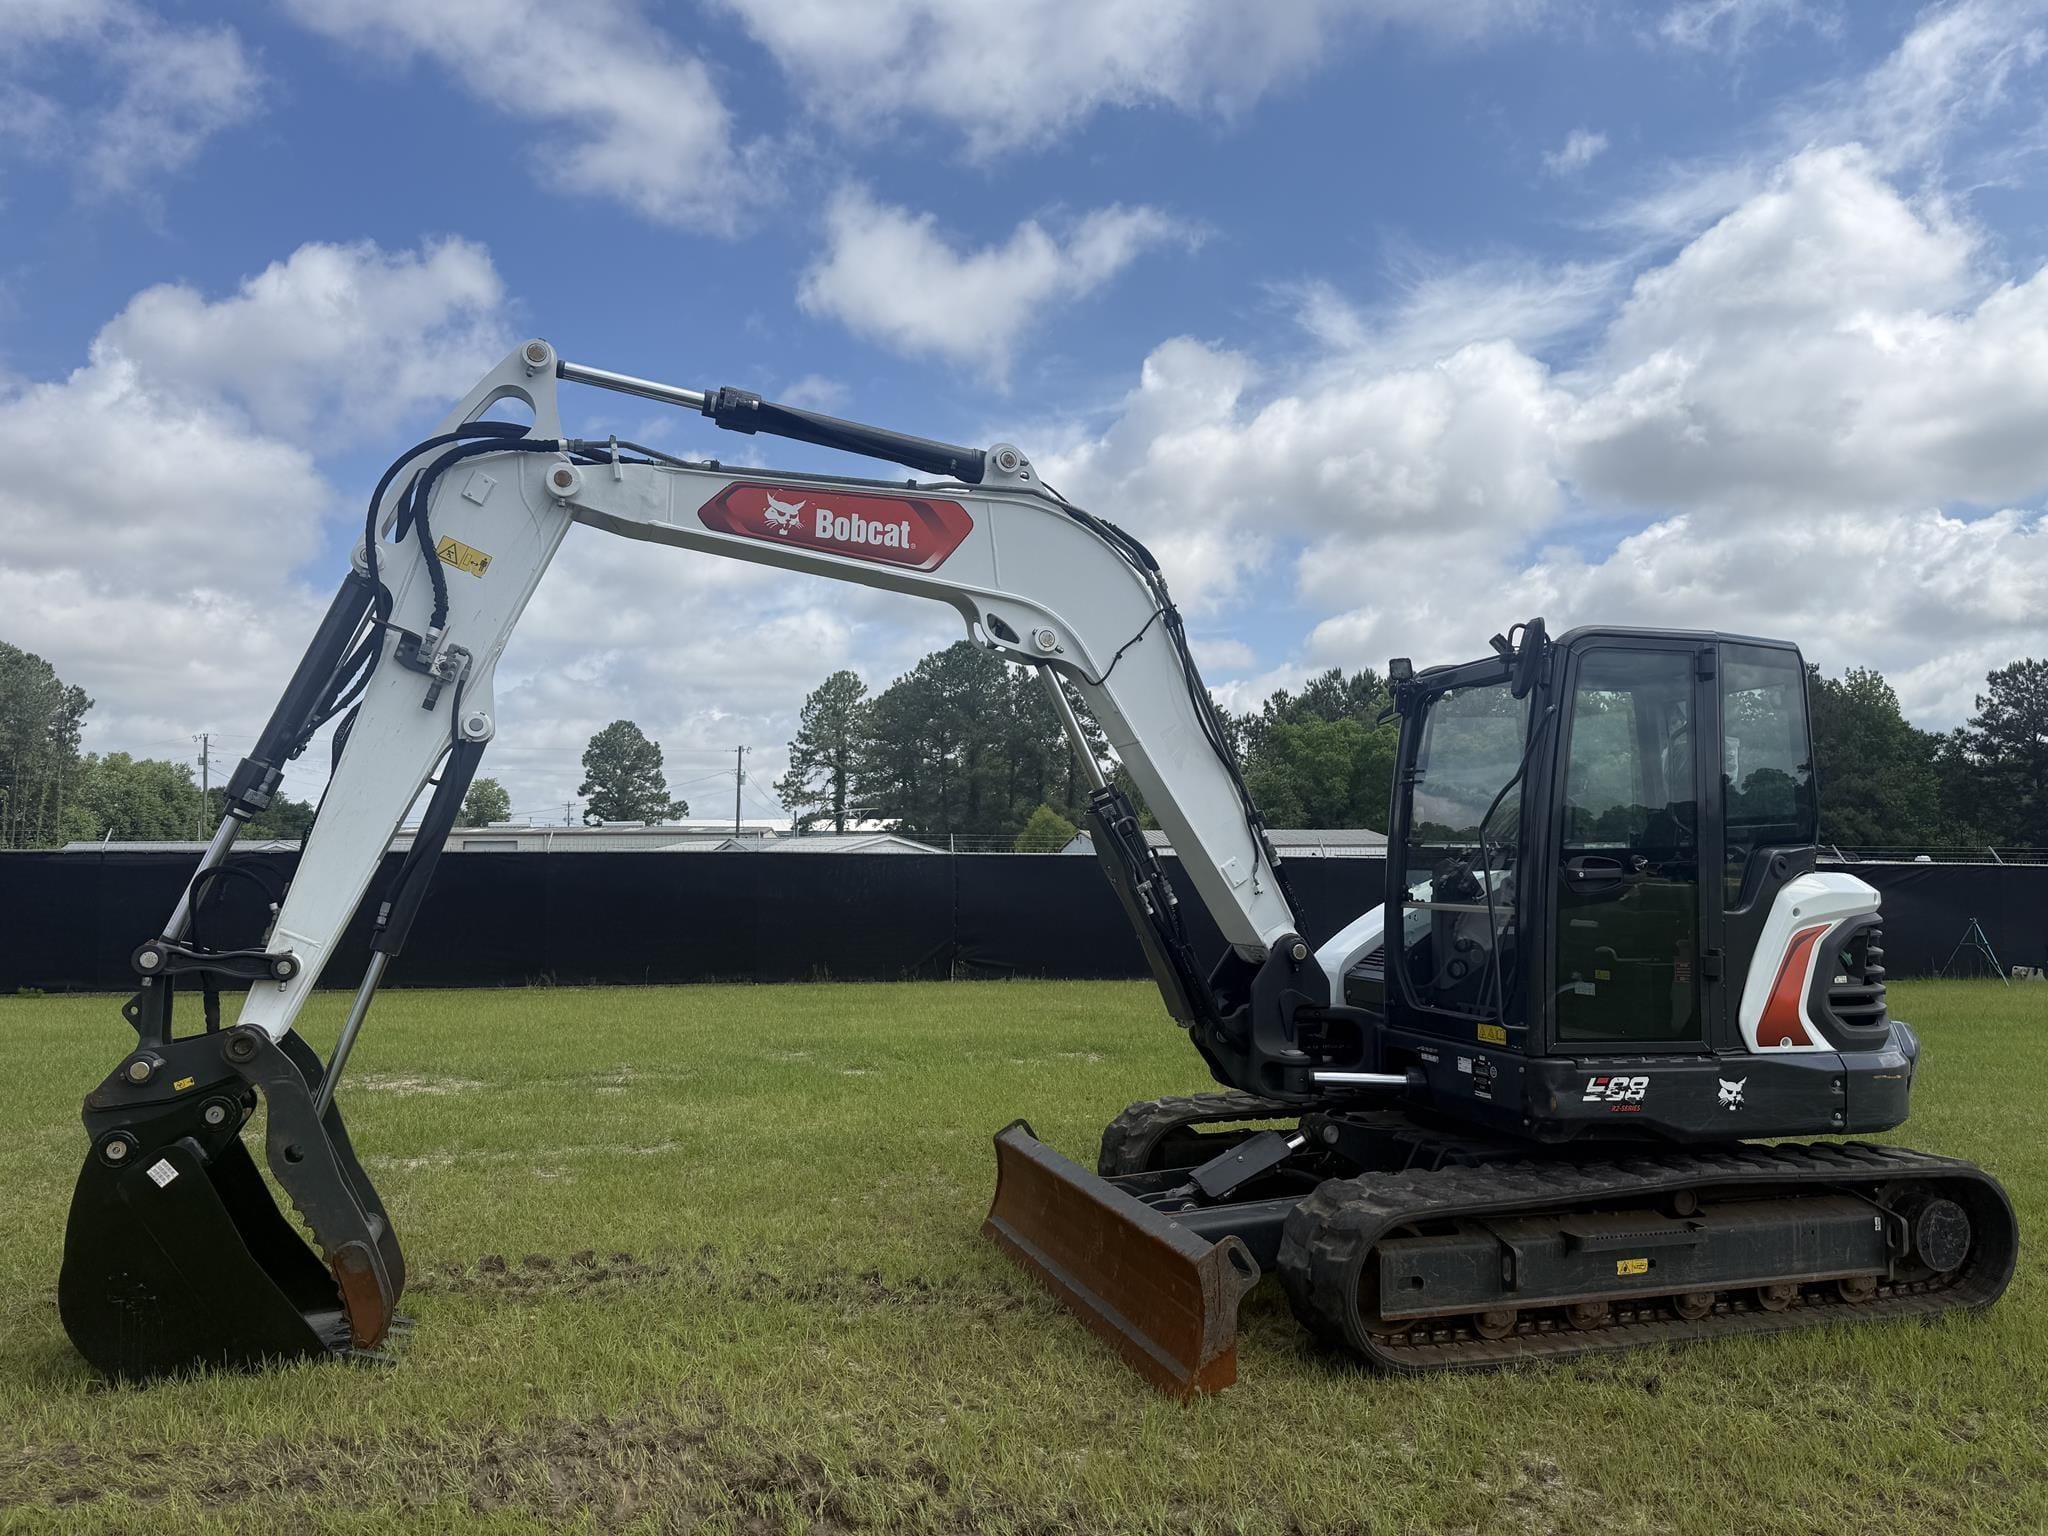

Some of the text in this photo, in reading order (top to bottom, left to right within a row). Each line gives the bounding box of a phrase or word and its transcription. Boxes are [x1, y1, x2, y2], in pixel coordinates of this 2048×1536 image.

[815, 508, 911, 549] Bobcat
[1582, 1076, 1650, 1102] E88
[1611, 1104, 1641, 1112] R2-SERIES
